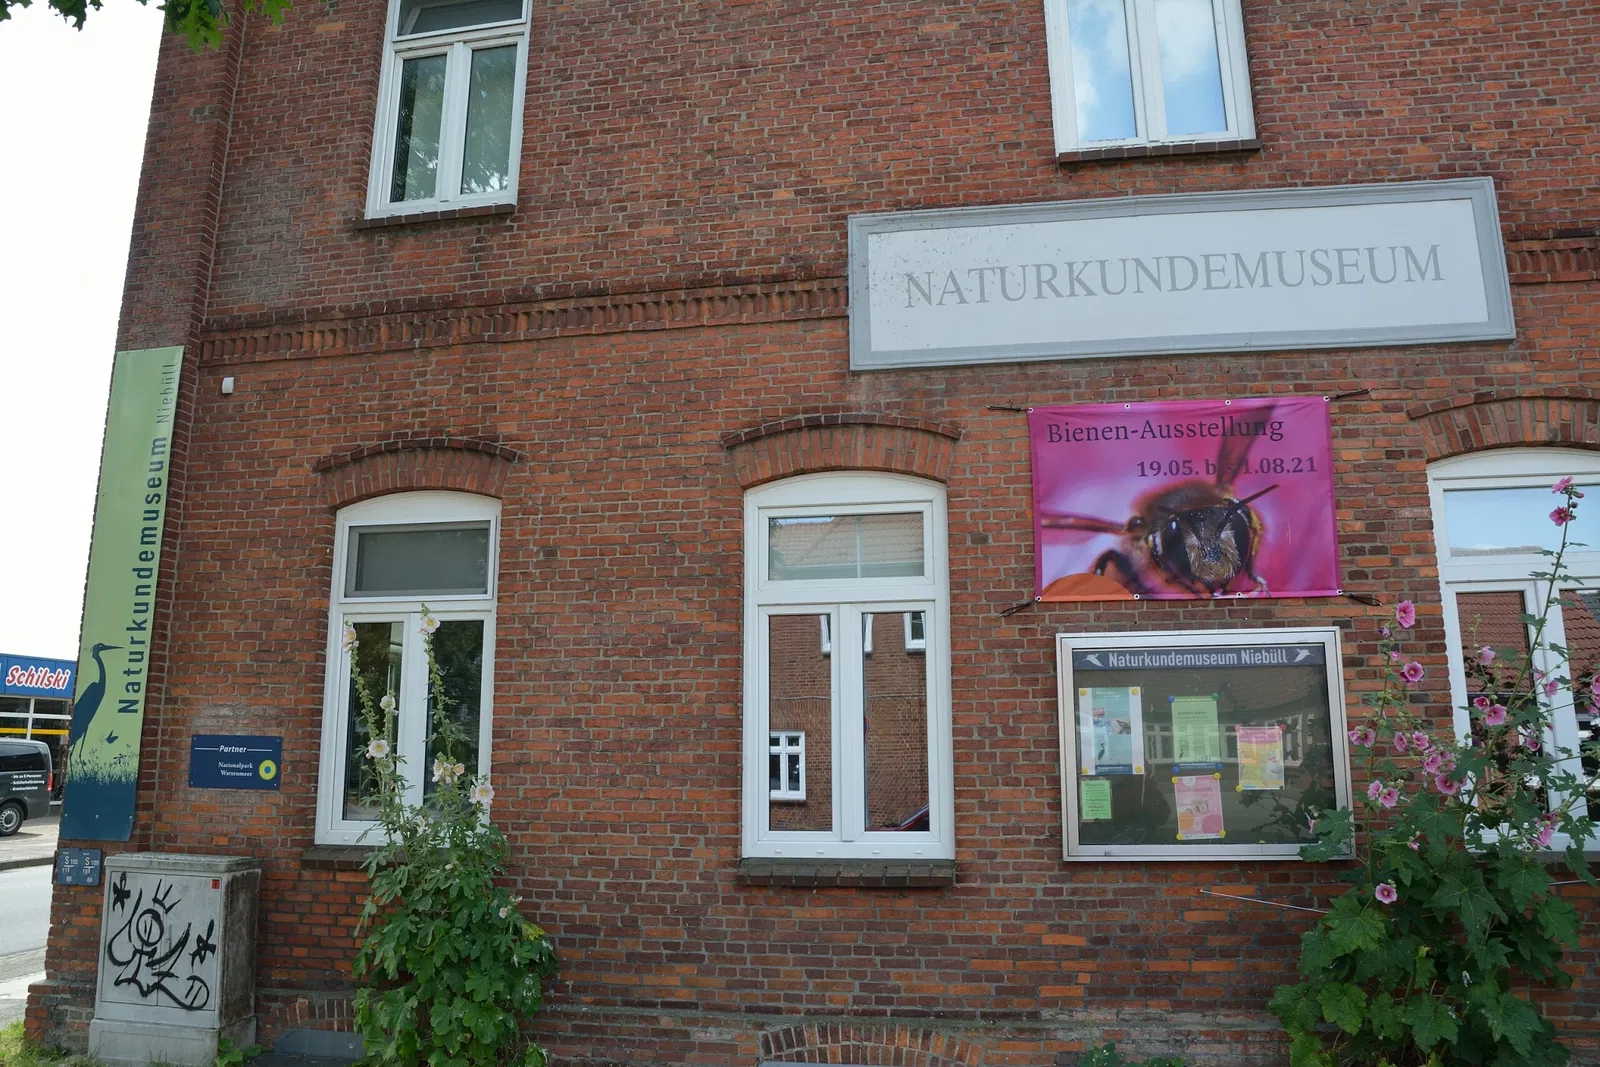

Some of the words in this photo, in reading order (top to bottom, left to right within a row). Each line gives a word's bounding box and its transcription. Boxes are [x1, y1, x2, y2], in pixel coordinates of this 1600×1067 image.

[904, 244, 1445, 308] NATURKUNDEMUSEUM
[1047, 416, 1284, 443] Bienen-Ausstellung
[1137, 459, 1200, 477] 19.05.
[117, 436, 168, 714] Naturkundemuseum
[155, 362, 178, 424] Niebüll
[1109, 651, 1238, 667] Naturkundemuseum
[1241, 649, 1288, 664] Niebüll
[6, 665, 71, 690] Schilski
[219, 744, 248, 753] Partner
[218, 761, 253, 770] Nationalpark
